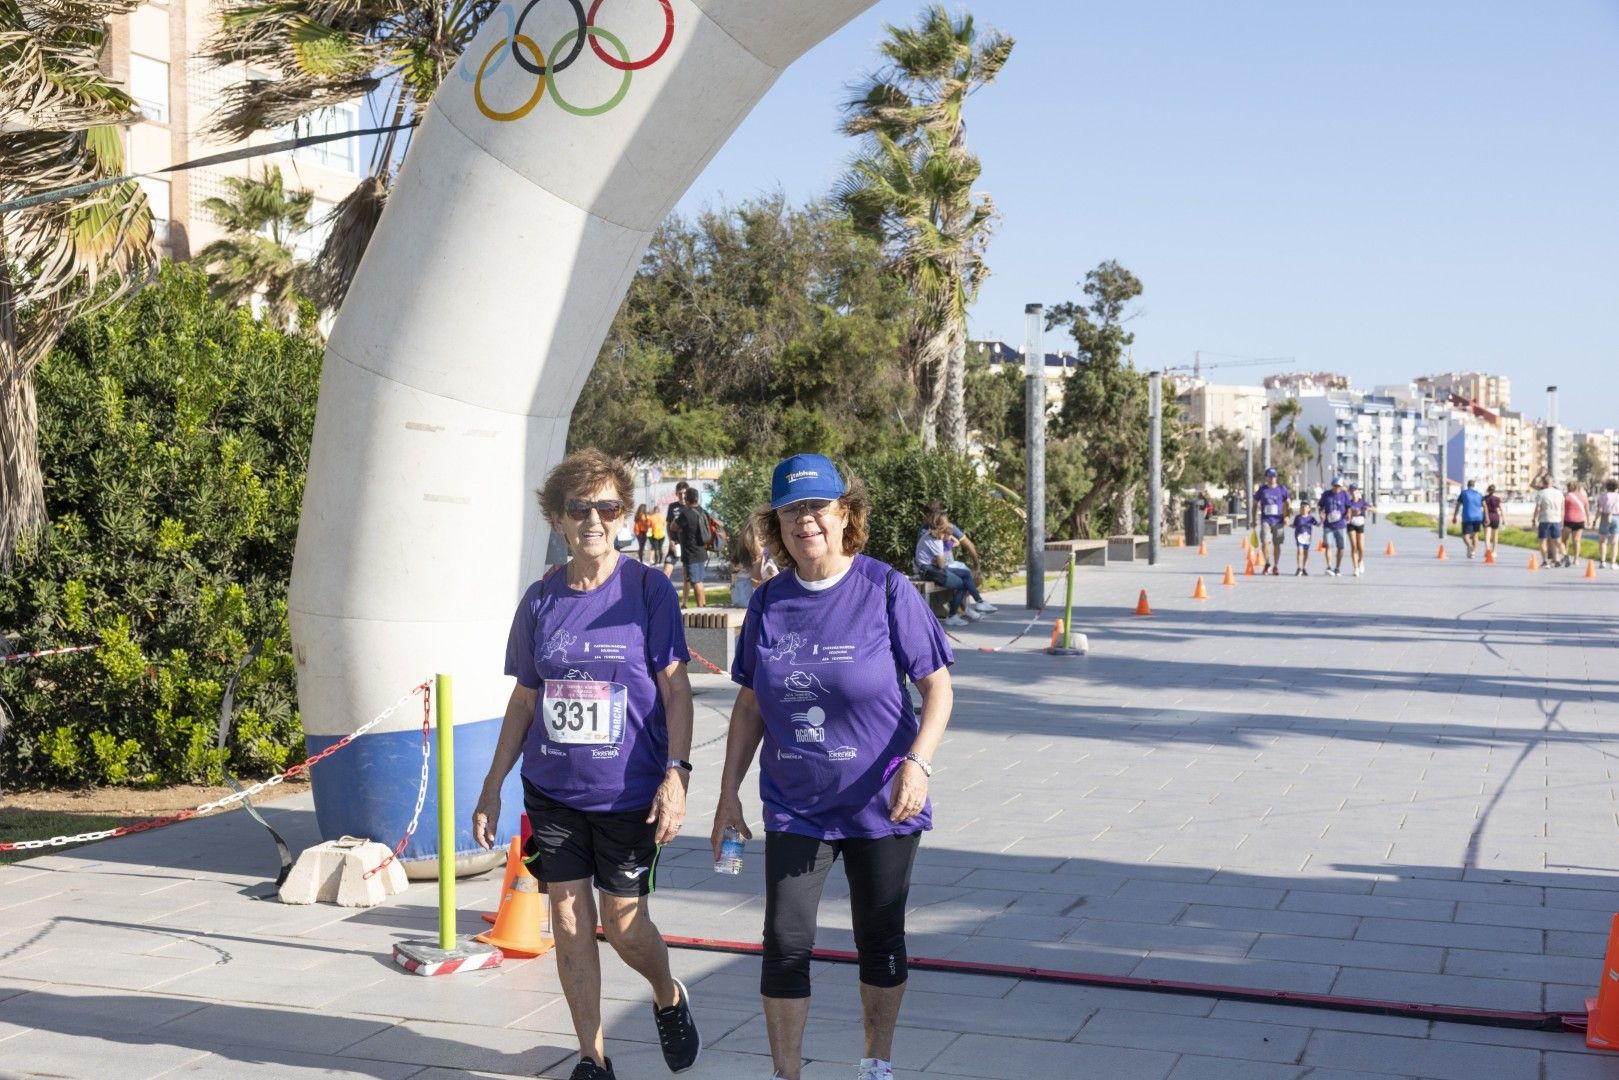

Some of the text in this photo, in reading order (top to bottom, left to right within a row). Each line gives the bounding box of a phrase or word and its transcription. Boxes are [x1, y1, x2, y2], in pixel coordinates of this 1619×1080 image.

[552, 701, 598, 732] 331
[613, 702, 622, 738] MARCHA
[795, 728, 825, 743] AGAMED
